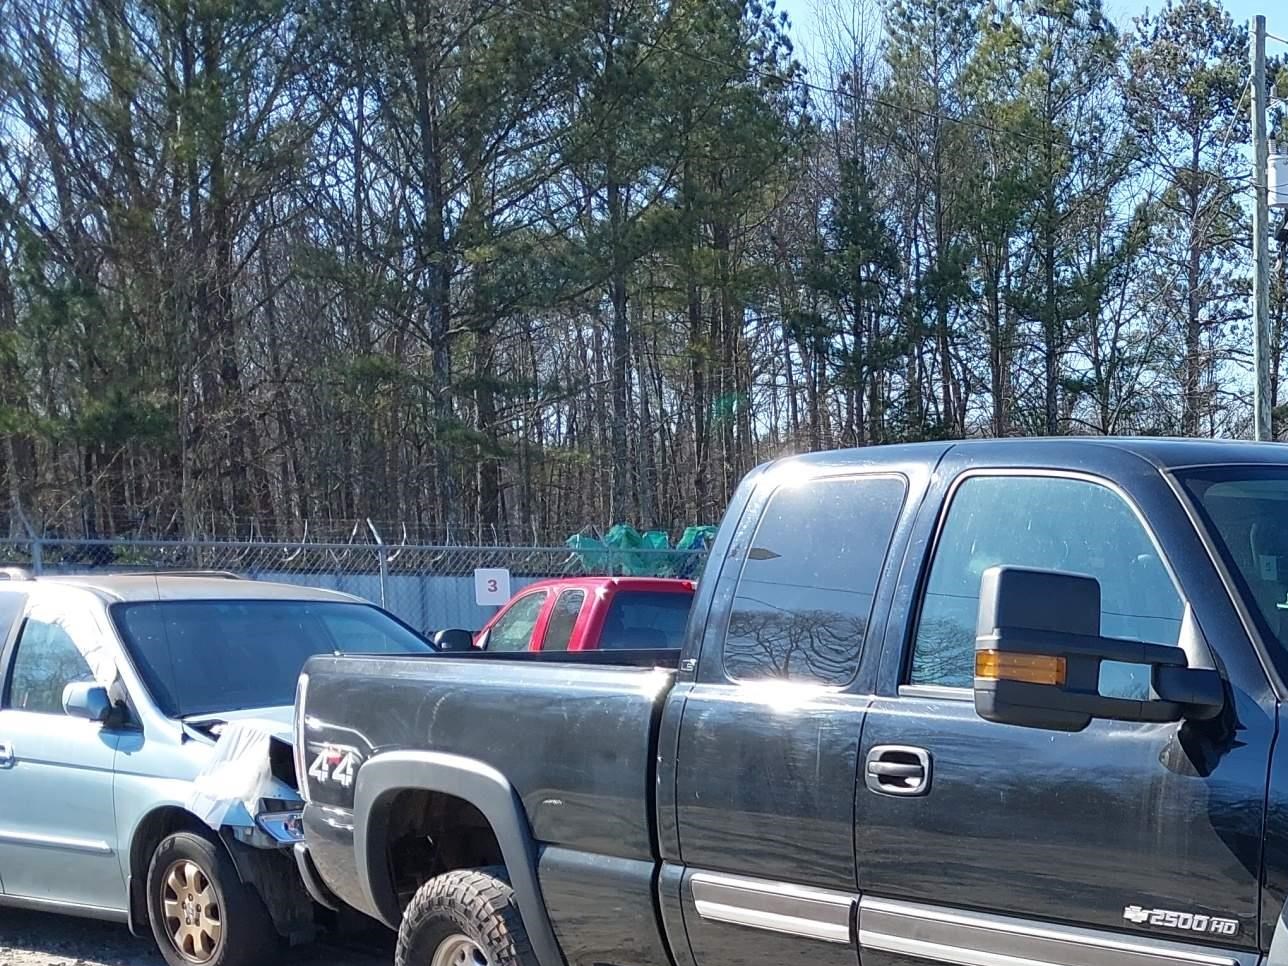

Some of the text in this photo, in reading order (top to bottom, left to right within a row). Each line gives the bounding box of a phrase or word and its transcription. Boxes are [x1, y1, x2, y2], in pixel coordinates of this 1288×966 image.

[488, 579, 498, 592] 3
[1150, 908, 1239, 934] 2500 HD
